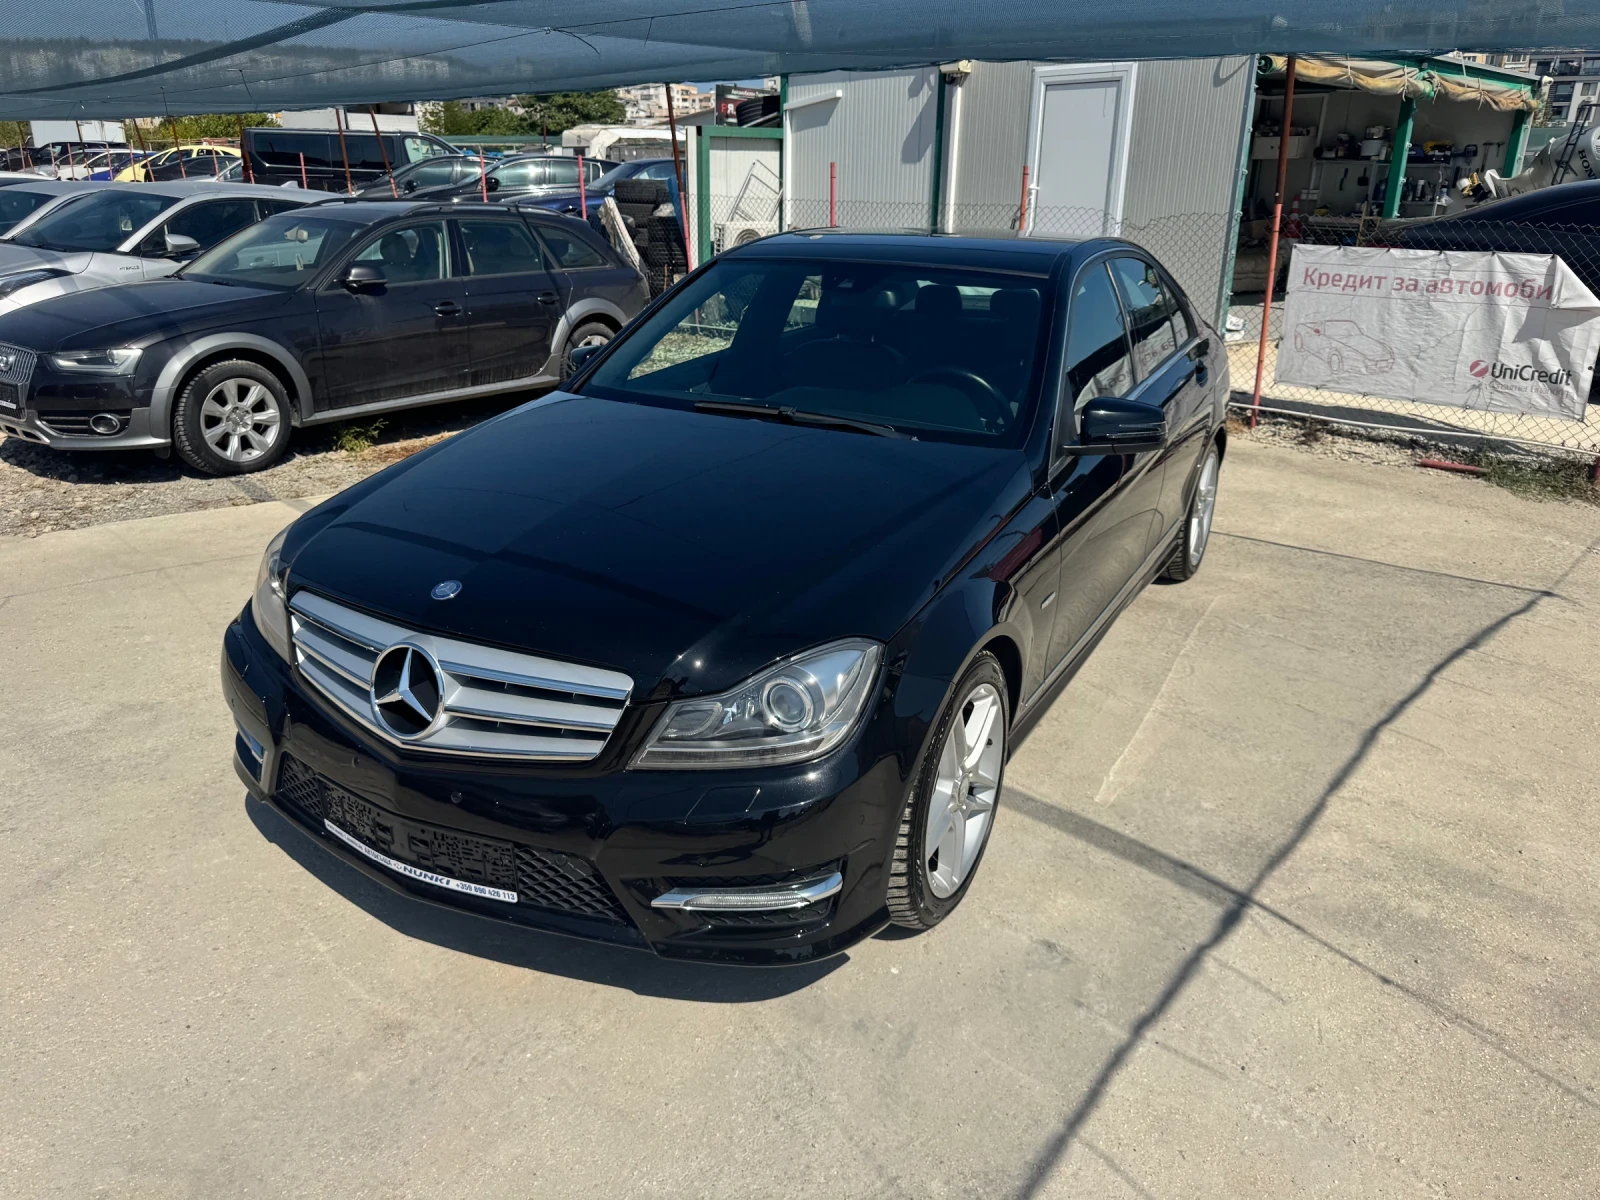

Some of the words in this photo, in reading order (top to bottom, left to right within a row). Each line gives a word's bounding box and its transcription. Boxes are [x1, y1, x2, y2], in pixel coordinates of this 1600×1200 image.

[1303, 267, 1388, 292] Кредит
[1391, 276, 1419, 293] за
[1491, 362, 1572, 386] UniCredit
[403, 865, 451, 886] NUNKI
[455, 882, 473, 892] +359
[502, 891, 515, 901] 113
